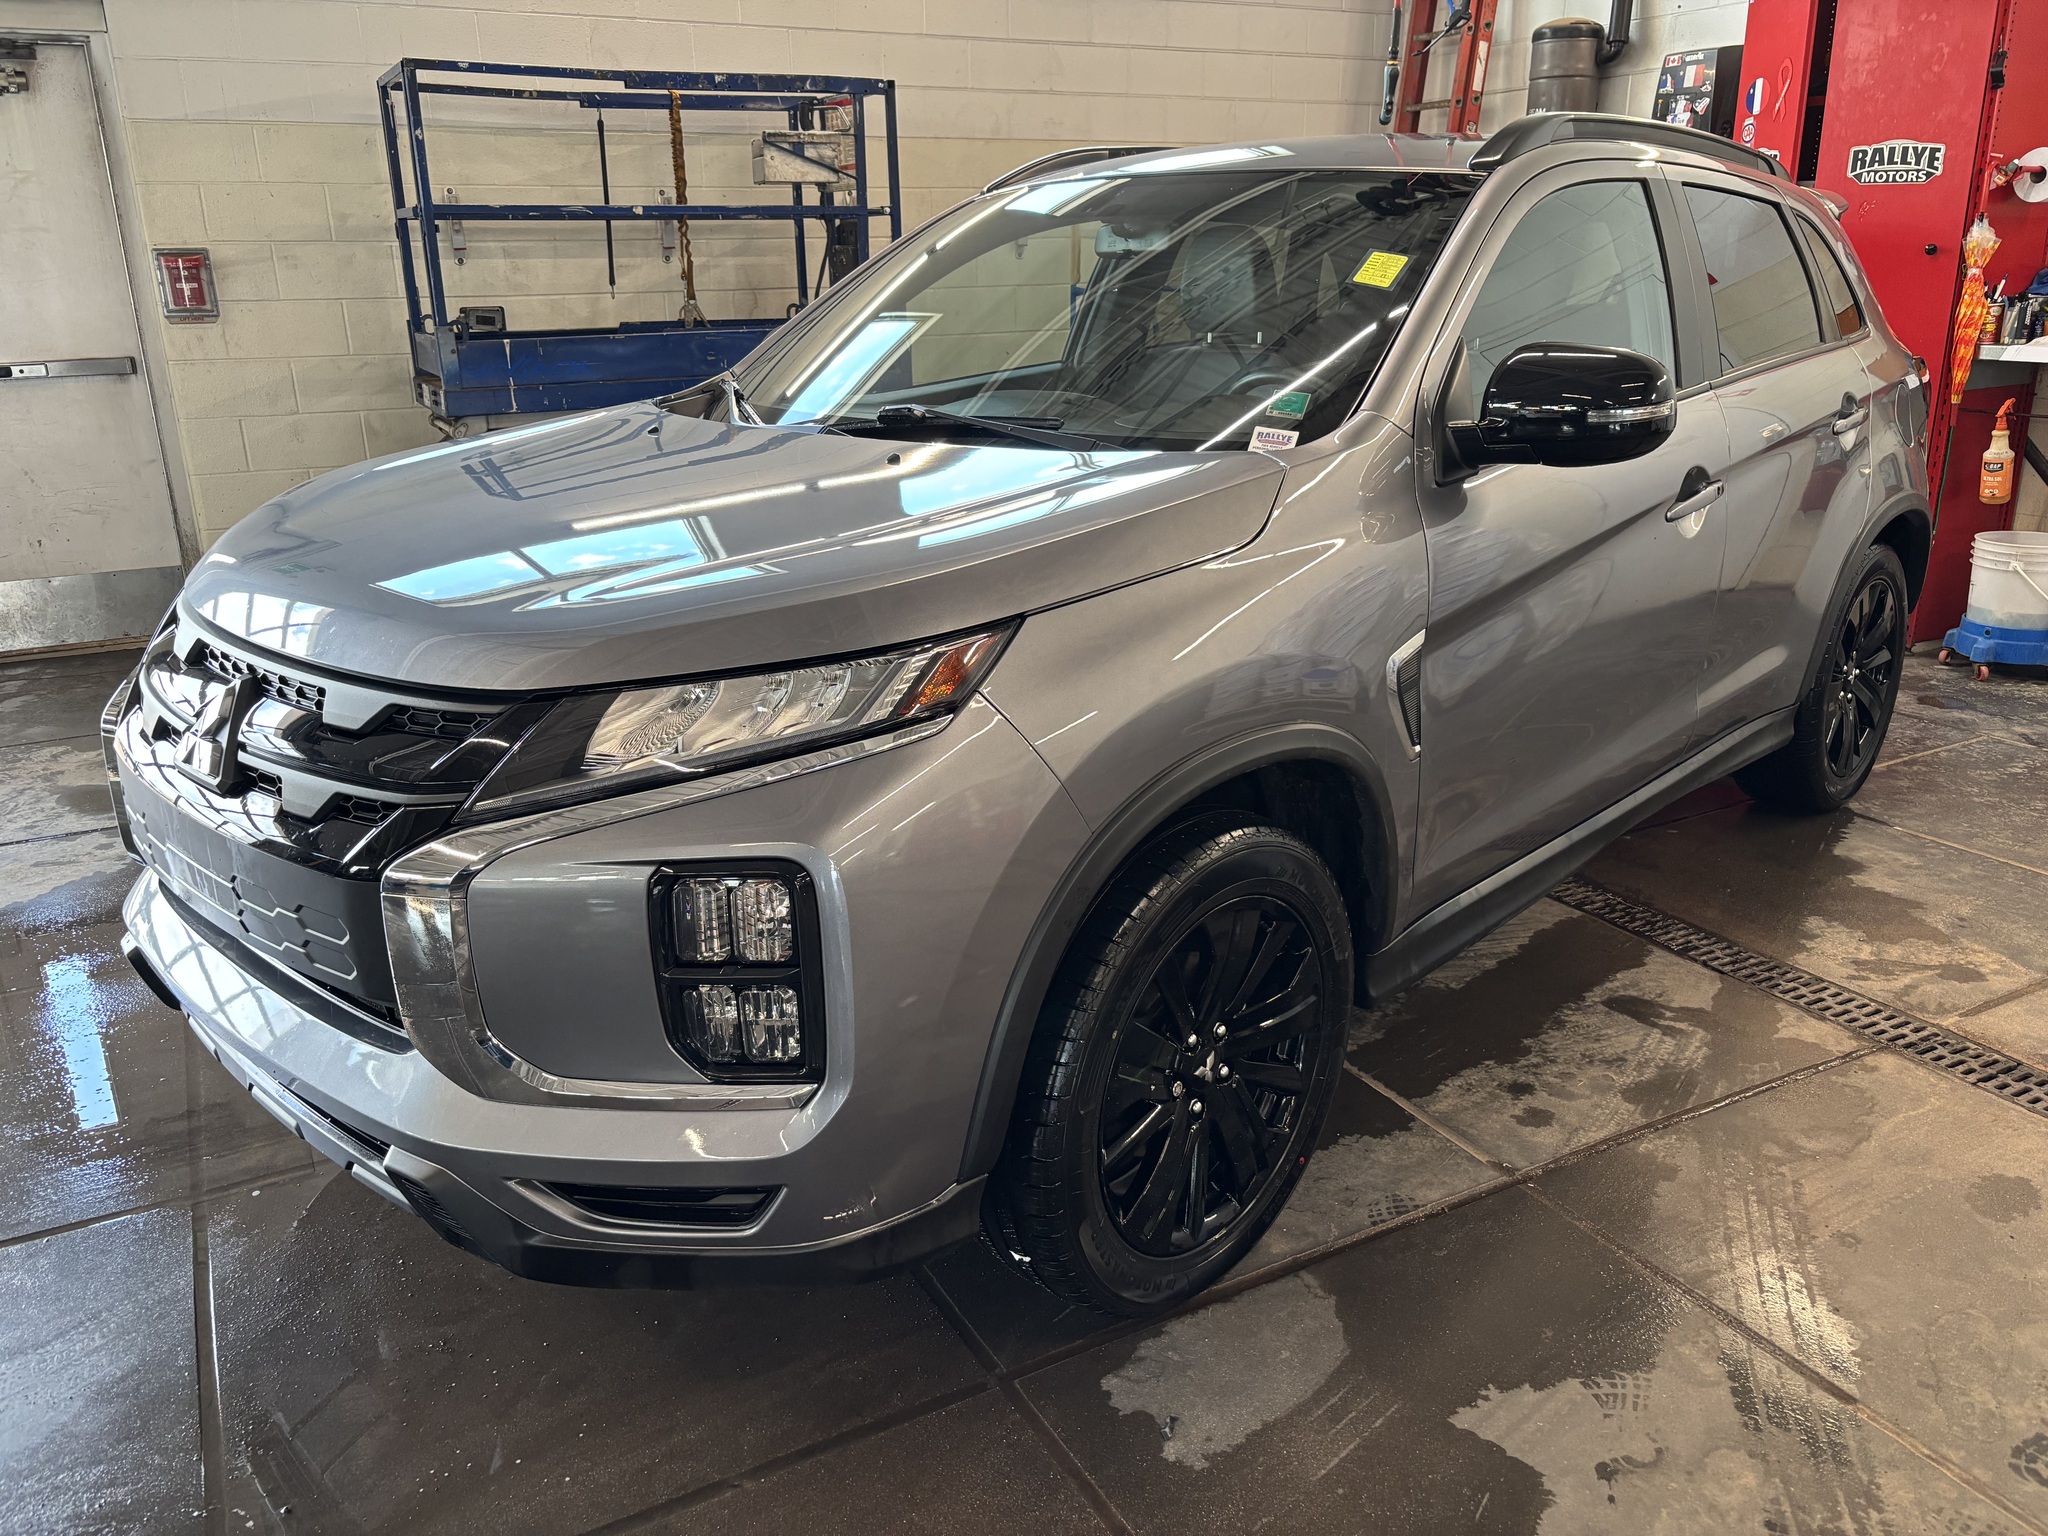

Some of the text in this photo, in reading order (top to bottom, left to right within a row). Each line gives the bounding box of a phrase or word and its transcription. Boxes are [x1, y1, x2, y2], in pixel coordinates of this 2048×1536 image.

[1850, 145, 1942, 173] RALLYE
[1860, 170, 1927, 183] MOTORS
[1256, 431, 1293, 444] RALLYE
